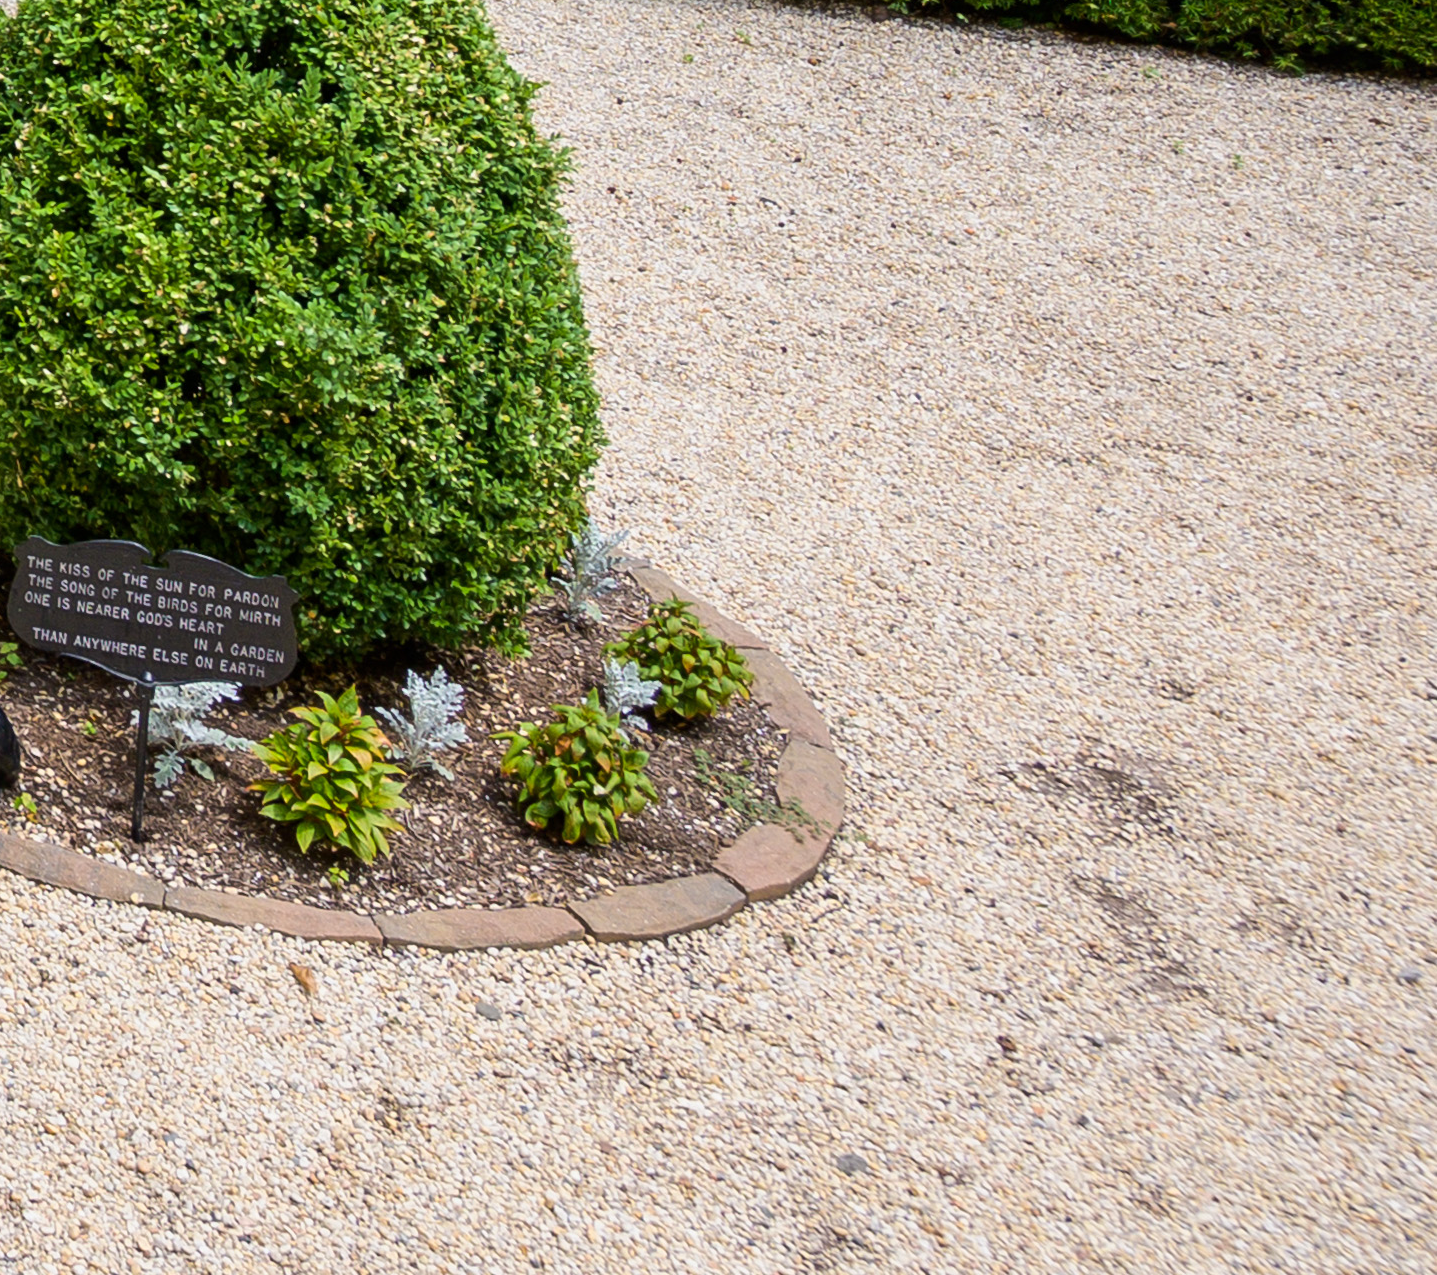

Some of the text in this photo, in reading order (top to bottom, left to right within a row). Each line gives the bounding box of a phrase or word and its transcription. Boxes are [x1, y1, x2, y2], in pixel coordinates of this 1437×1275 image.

[27, 555, 279, 609] THE KISS OF THE SUN FOR PARDON
[28, 574, 281, 627] THE SONG OF THE BIRDS FOR MIRTH
[24, 591, 224, 635] ONE IS NEARER GOD'S HEART
[32, 627, 265, 678] THAN ANYWHERE ELSE ON EARTH
[194, 638, 285, 664] IN A GARDEN
